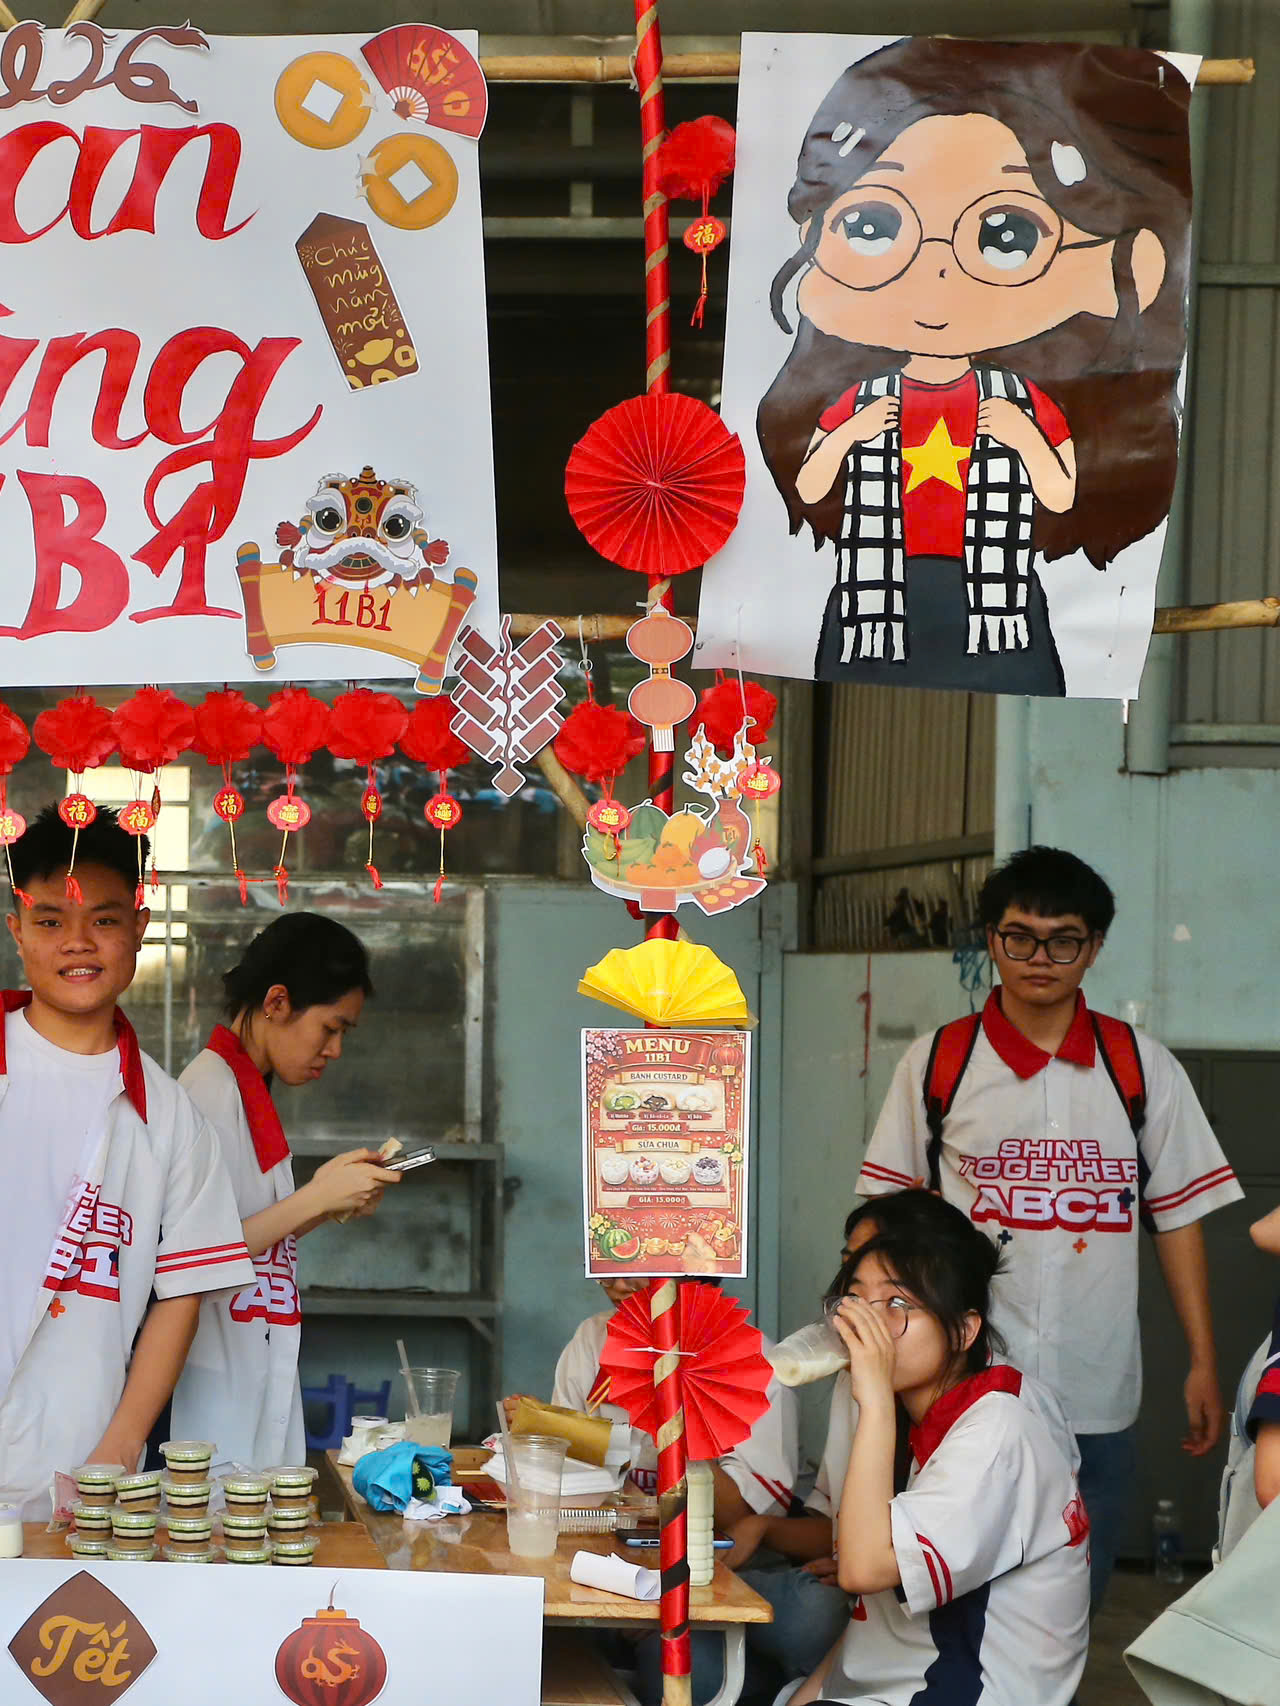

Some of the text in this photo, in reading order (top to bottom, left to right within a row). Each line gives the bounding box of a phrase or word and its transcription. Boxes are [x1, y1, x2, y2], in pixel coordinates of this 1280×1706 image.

[312, 590, 393, 632] 11B1
[625, 1038, 691, 1054] MENU
[645, 1054, 671, 1063] 11B1
[653, 1072, 688, 1081] CUSTARD
[656, 1140, 680, 1149] CHUA
[998, 1138, 1102, 1160] SHINE
[959, 1155, 1138, 1182] TOGETHER
[970, 1184, 1133, 1233] ABC1
[30, 1614, 132, 1687] Tết
